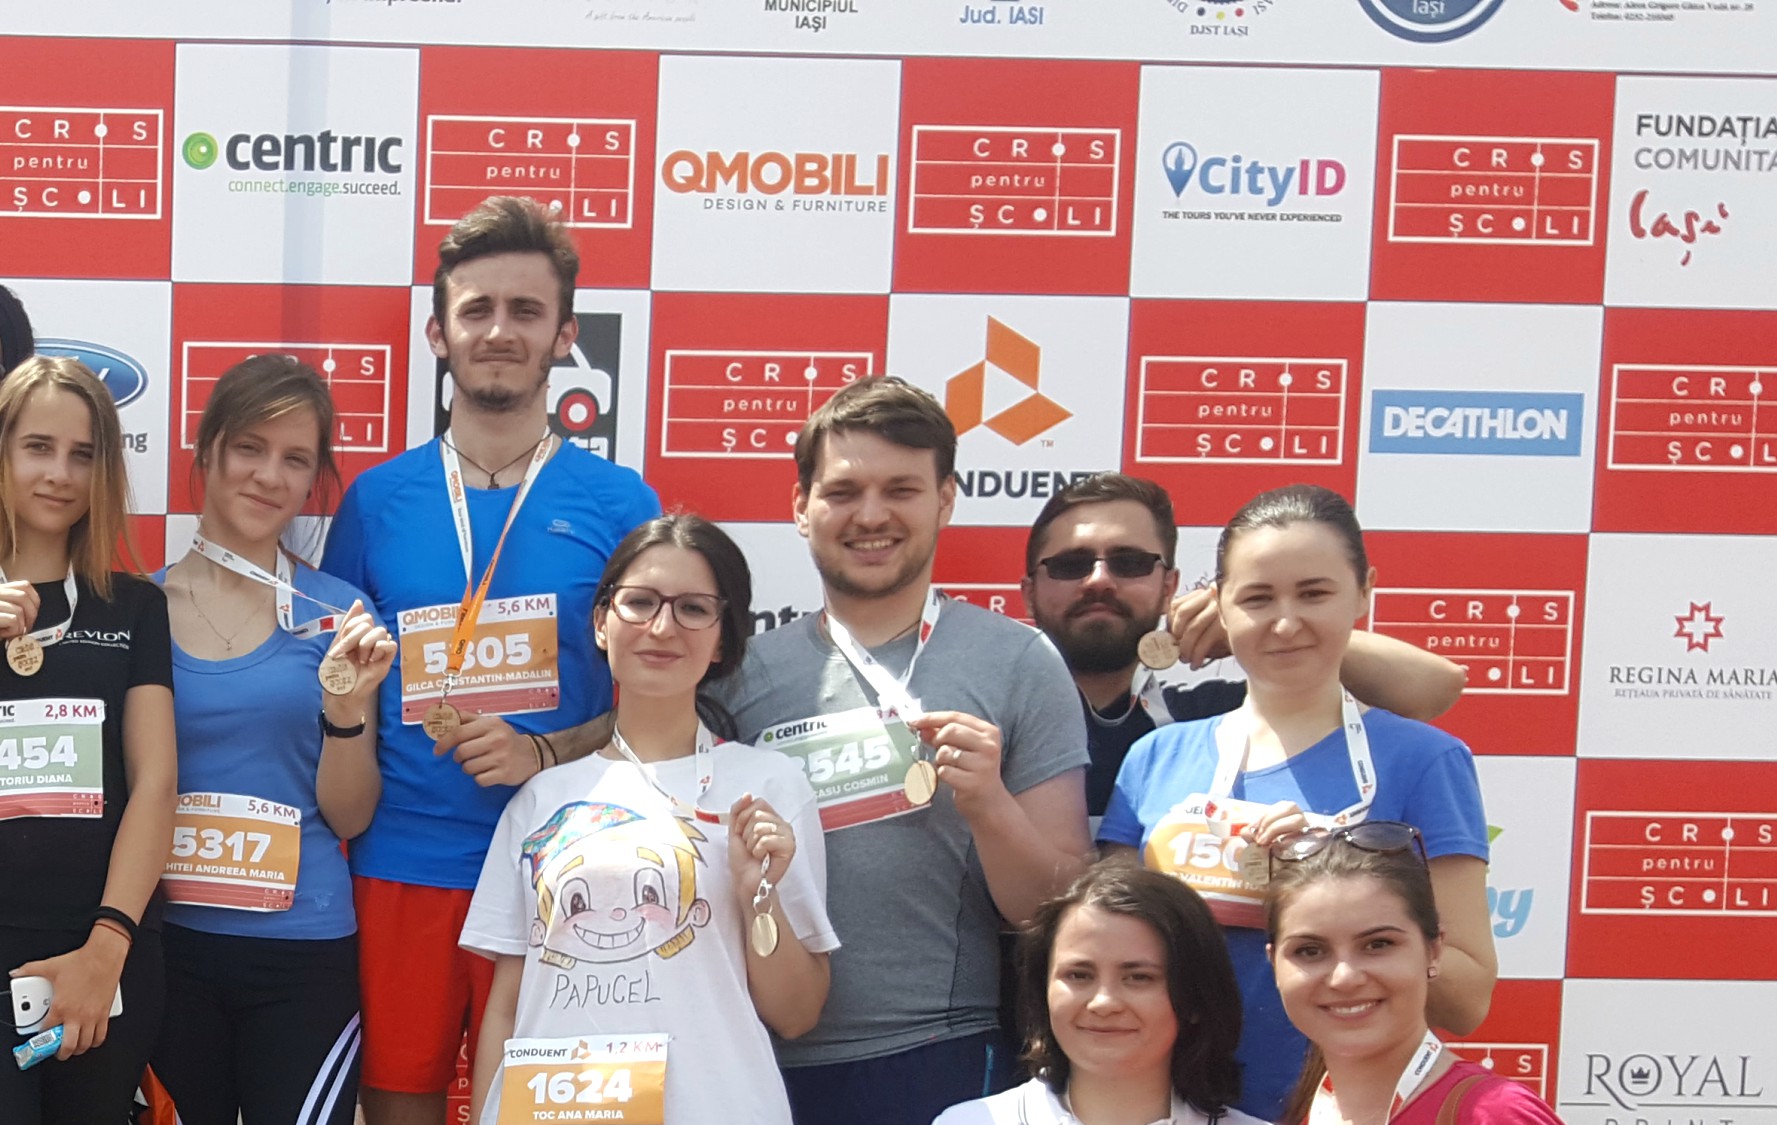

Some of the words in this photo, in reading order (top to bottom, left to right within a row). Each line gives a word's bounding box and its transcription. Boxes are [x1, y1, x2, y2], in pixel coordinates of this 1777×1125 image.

[959, 5, 1002, 25] Jud.
[1190, 25, 1221, 36] DJST
[225, 129, 403, 175] centric
[13, 153, 89, 171] pentru
[485, 162, 561, 181] pentru
[660, 150, 890, 196] QMOBILI
[970, 171, 1046, 190] pentru
[1198, 154, 1347, 208] CityID
[1449, 180, 1525, 200] pentru
[703, 198, 768, 211] DESIGN
[774, 199, 786, 212] &
[792, 198, 888, 213] FURNITURE
[1162, 210, 1181, 220] THE
[1182, 211, 1212, 221] TOURS
[1247, 212, 1278, 222] NEVER
[1279, 213, 1342, 223] EXPERIENCED
[723, 395, 798, 413] pentru
[1198, 402, 1273, 420] pentru
[1383, 406, 1568, 441] DECATHLON
[1668, 409, 1743, 428] pentru
[497, 600, 521, 616] 5,6
[524, 596, 551, 611] KM
[1427, 634, 1501, 651] pentru
[1609, 666, 1698, 686] REGINA
[405, 680, 435, 693] GILCA
[44, 704, 69, 720] 2,8
[72, 704, 98, 718] KM
[36, 774, 73, 785] DIANA
[842, 773, 889, 792] COSMIN
[247, 799, 270, 815] 5,6
[273, 804, 297, 820] KM
[171, 826, 272, 863] 5317
[195, 864, 247, 877] ANDREEA
[249, 869, 285, 881] MARIA
[1642, 855, 1716, 873] pentru
[549, 970, 662, 1010] PAPUCEL
[509, 1048, 569, 1059] CONDUENT
[633, 1041, 661, 1053] KM
[526, 1069, 633, 1105] 1624
[1582, 1052, 1764, 1112] ROYAL
[532, 1110, 556, 1120] TOC
[557, 1110, 583, 1120] ANA
[584, 1110, 624, 1120] MARIA
